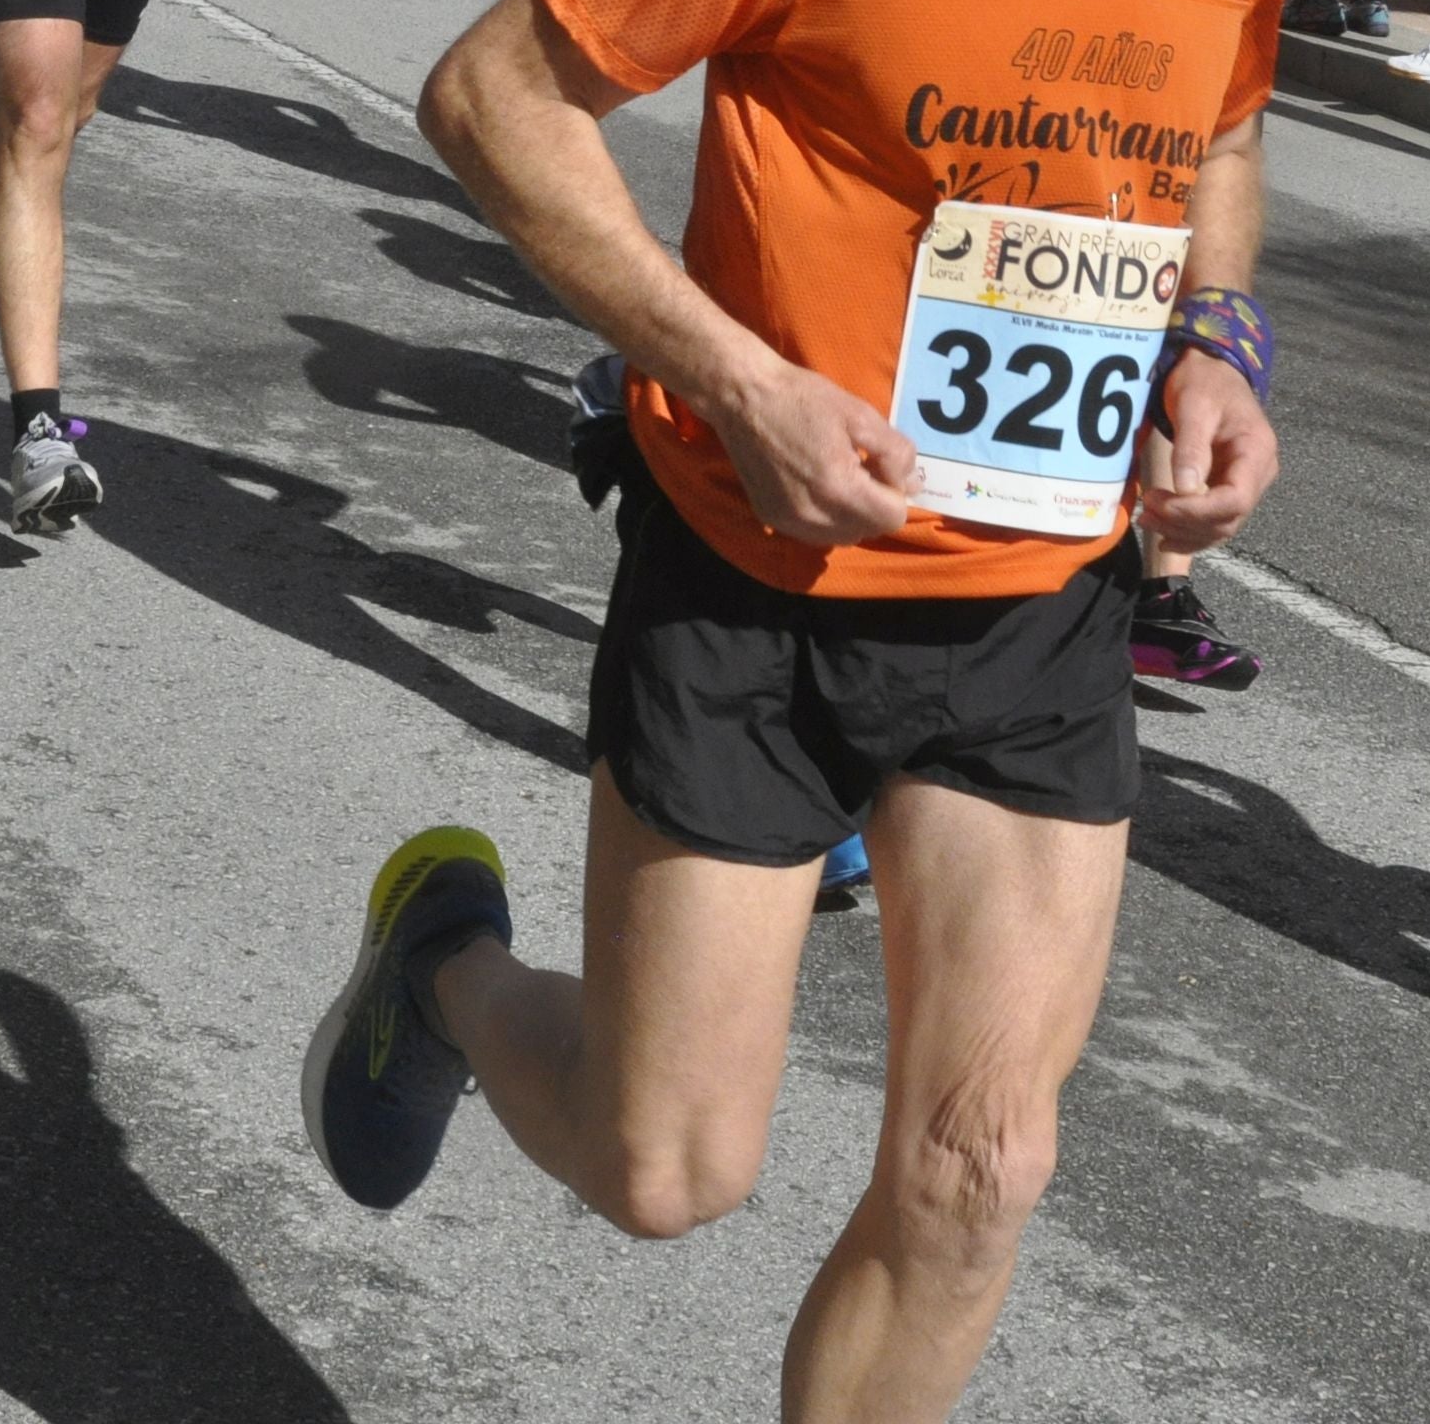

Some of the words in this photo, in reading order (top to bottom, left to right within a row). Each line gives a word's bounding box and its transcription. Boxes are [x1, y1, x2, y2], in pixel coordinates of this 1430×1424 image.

[1011, 27, 1075, 82] 40
[1071, 31, 1175, 93] AÑOS
[904, 82, 1205, 173] Cantarranas
[994, 238, 1179, 304] FONDO
[1002, 220, 1073, 250] GRAN
[1079, 231, 1162, 262] PREMIO
[1035, 320, 1060, 332] Media
[916, 328, 1141, 459] 326
